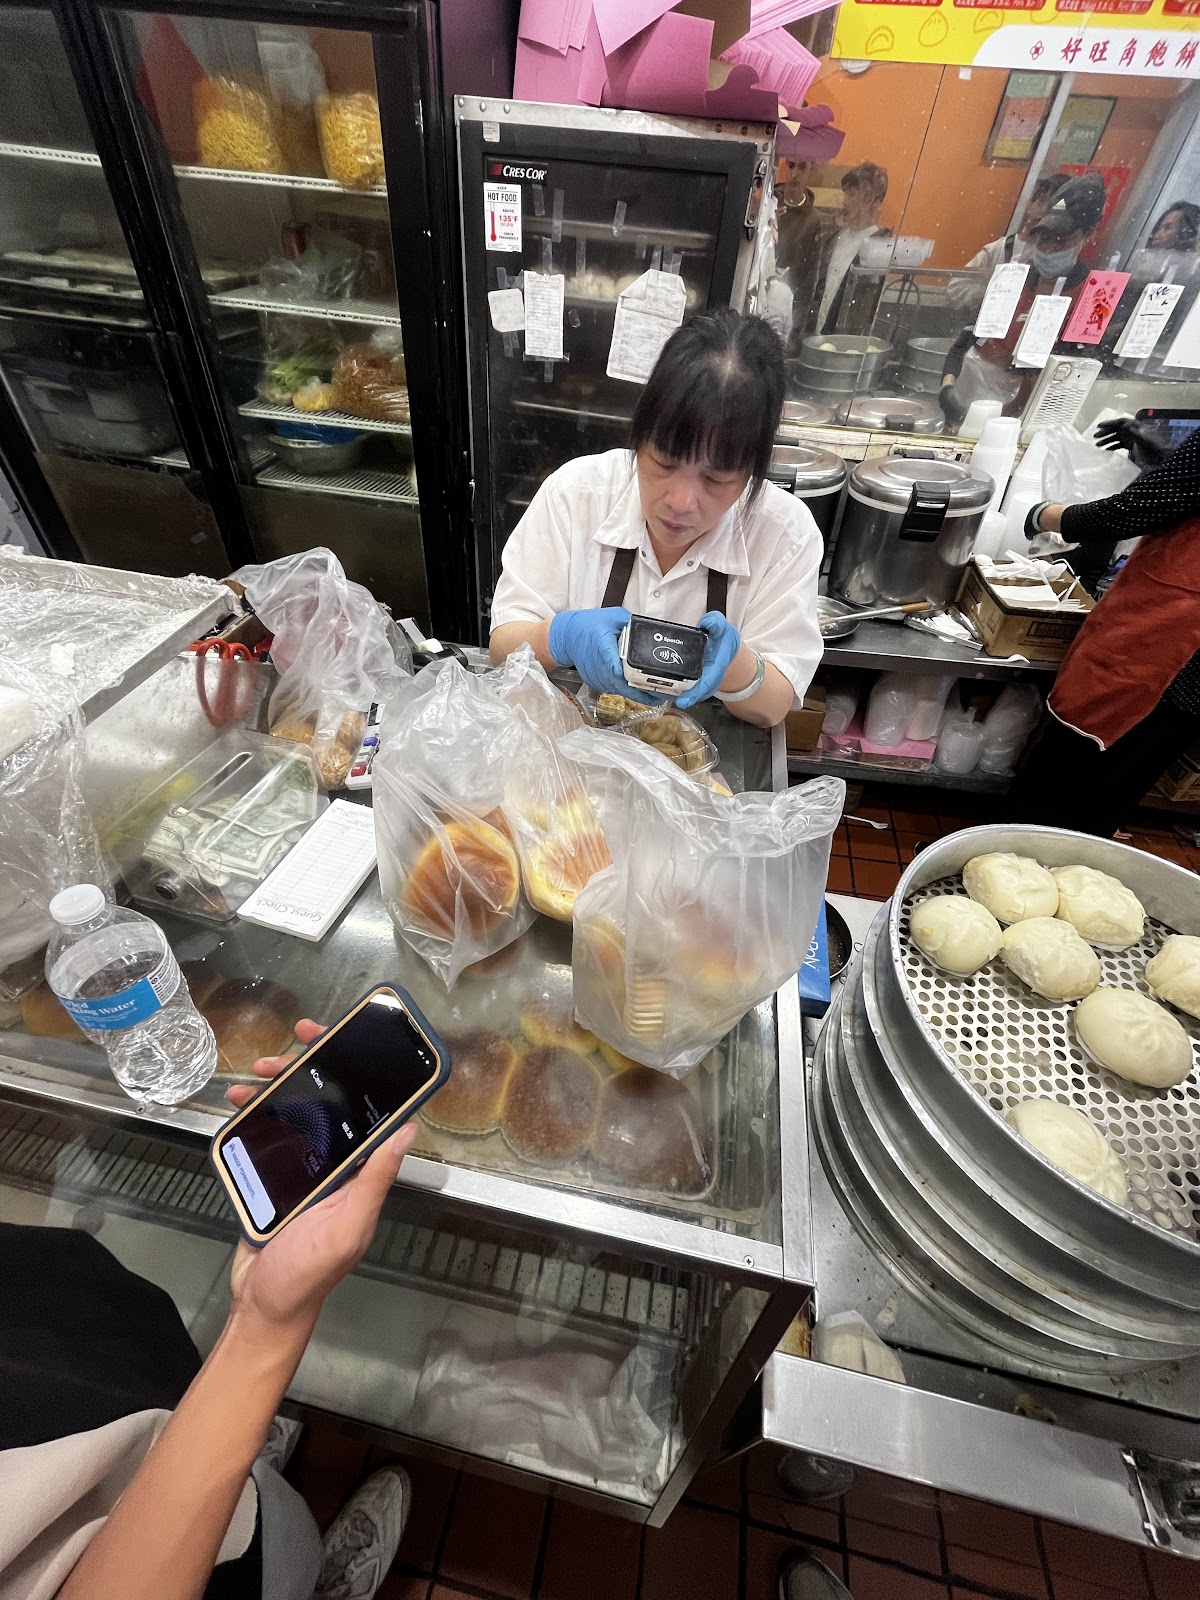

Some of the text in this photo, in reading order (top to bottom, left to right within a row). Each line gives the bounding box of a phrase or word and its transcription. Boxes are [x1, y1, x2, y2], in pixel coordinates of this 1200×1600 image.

[502, 165, 526, 178] CRES
[487, 192, 517, 202] HOT FOOD
[255, 897, 288, 913] Check
[289, 908, 322, 922] Guest
[803, 935, 820, 970] Poly
[98, 999, 135, 1015] Water
[308, 1153, 320, 1173] VISA
